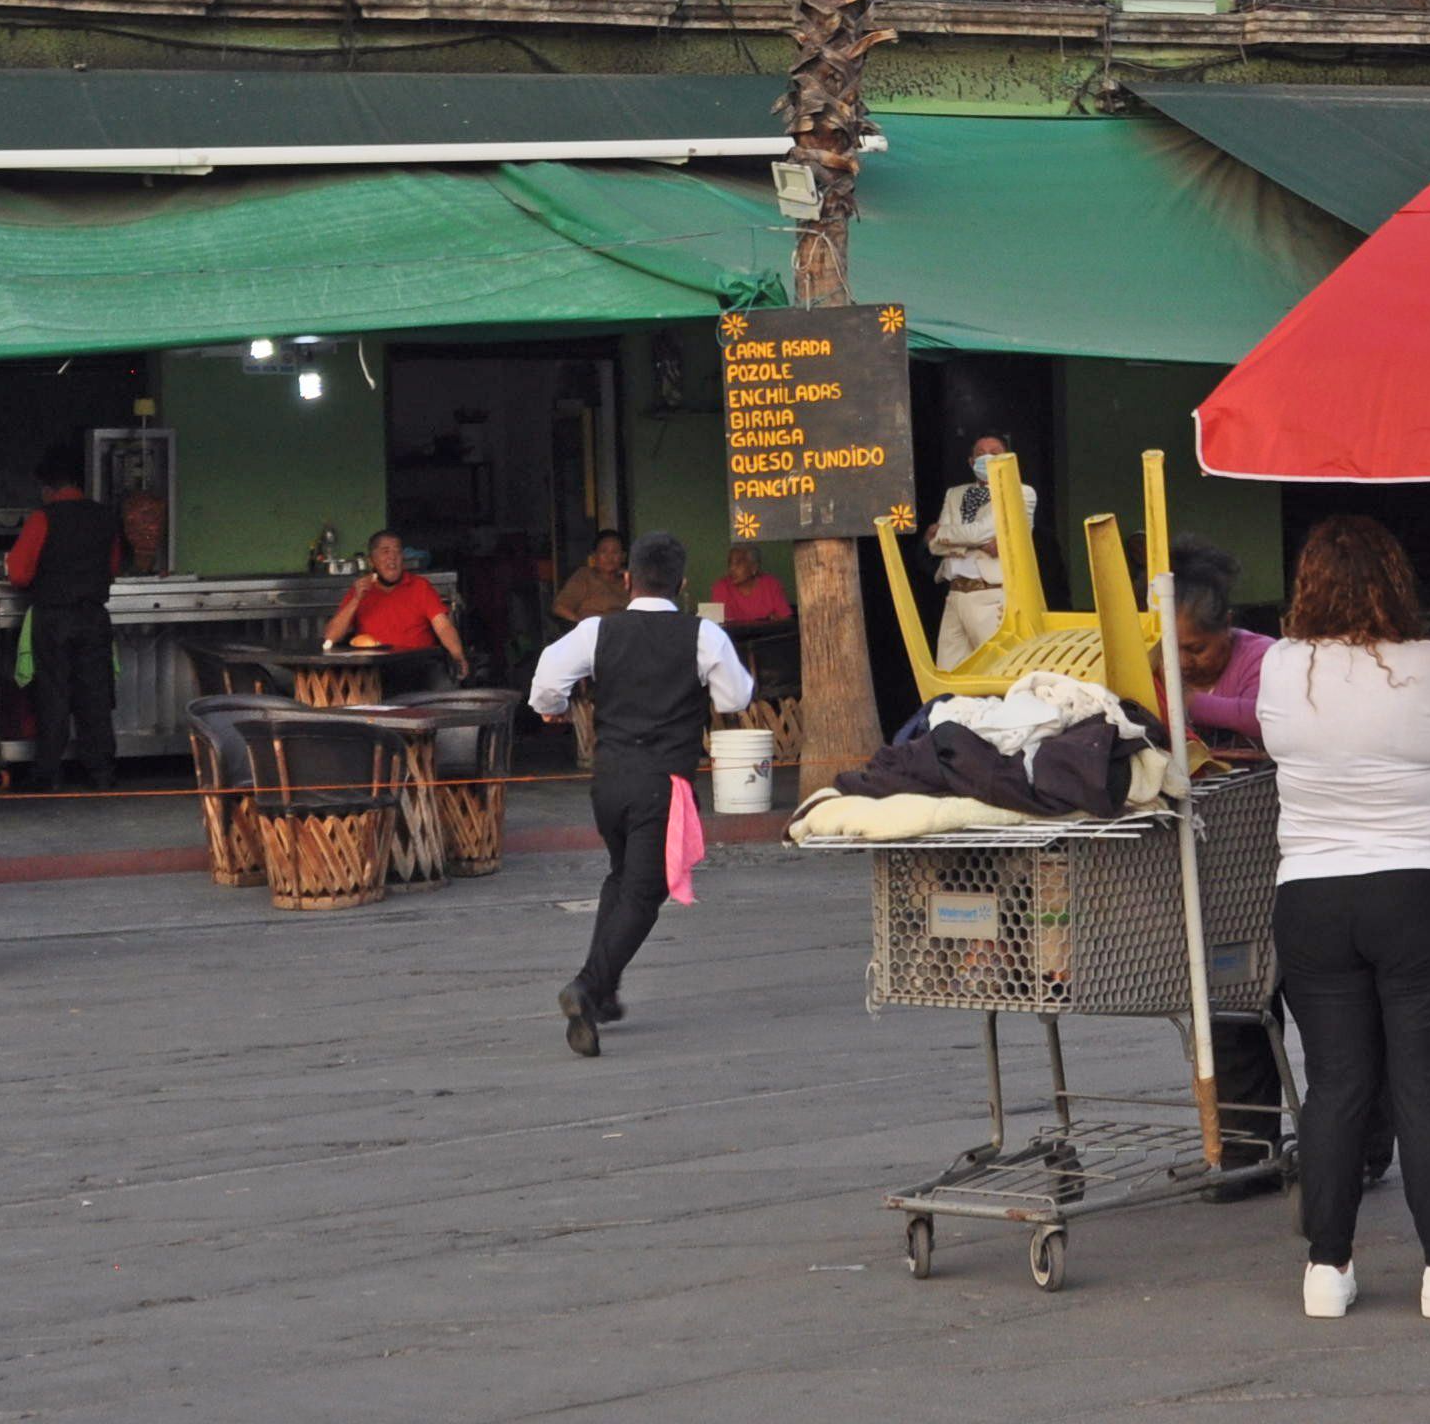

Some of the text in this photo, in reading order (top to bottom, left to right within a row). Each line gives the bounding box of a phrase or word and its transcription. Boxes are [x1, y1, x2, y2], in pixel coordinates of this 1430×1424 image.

[724, 340, 831, 361] CARNE ASADA
[726, 363, 794, 384] POZOLE
[730, 409, 795, 430] BIRRIA
[731, 452, 794, 474] QUESO
[734, 475, 815, 500] PANCITA
